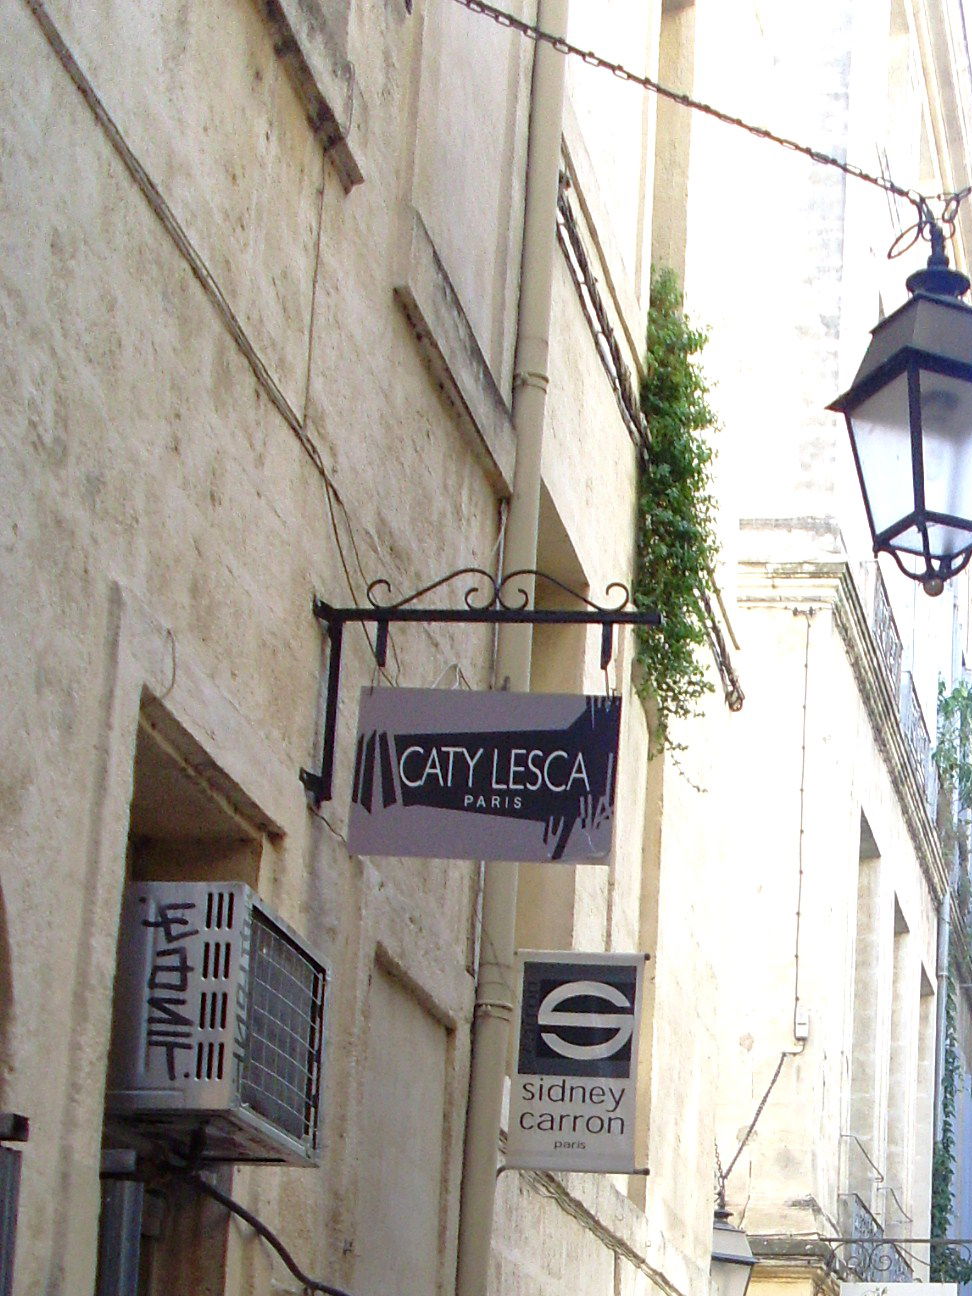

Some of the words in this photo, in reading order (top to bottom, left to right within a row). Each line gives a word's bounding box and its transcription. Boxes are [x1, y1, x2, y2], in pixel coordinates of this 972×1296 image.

[400, 746, 483, 788] CATY
[491, 749, 590, 792] LESCA
[464, 795, 522, 808] PARIS
[522, 1078, 625, 1112] sidney
[519, 1111, 625, 1134] carron
[554, 1140, 586, 1150] paris
